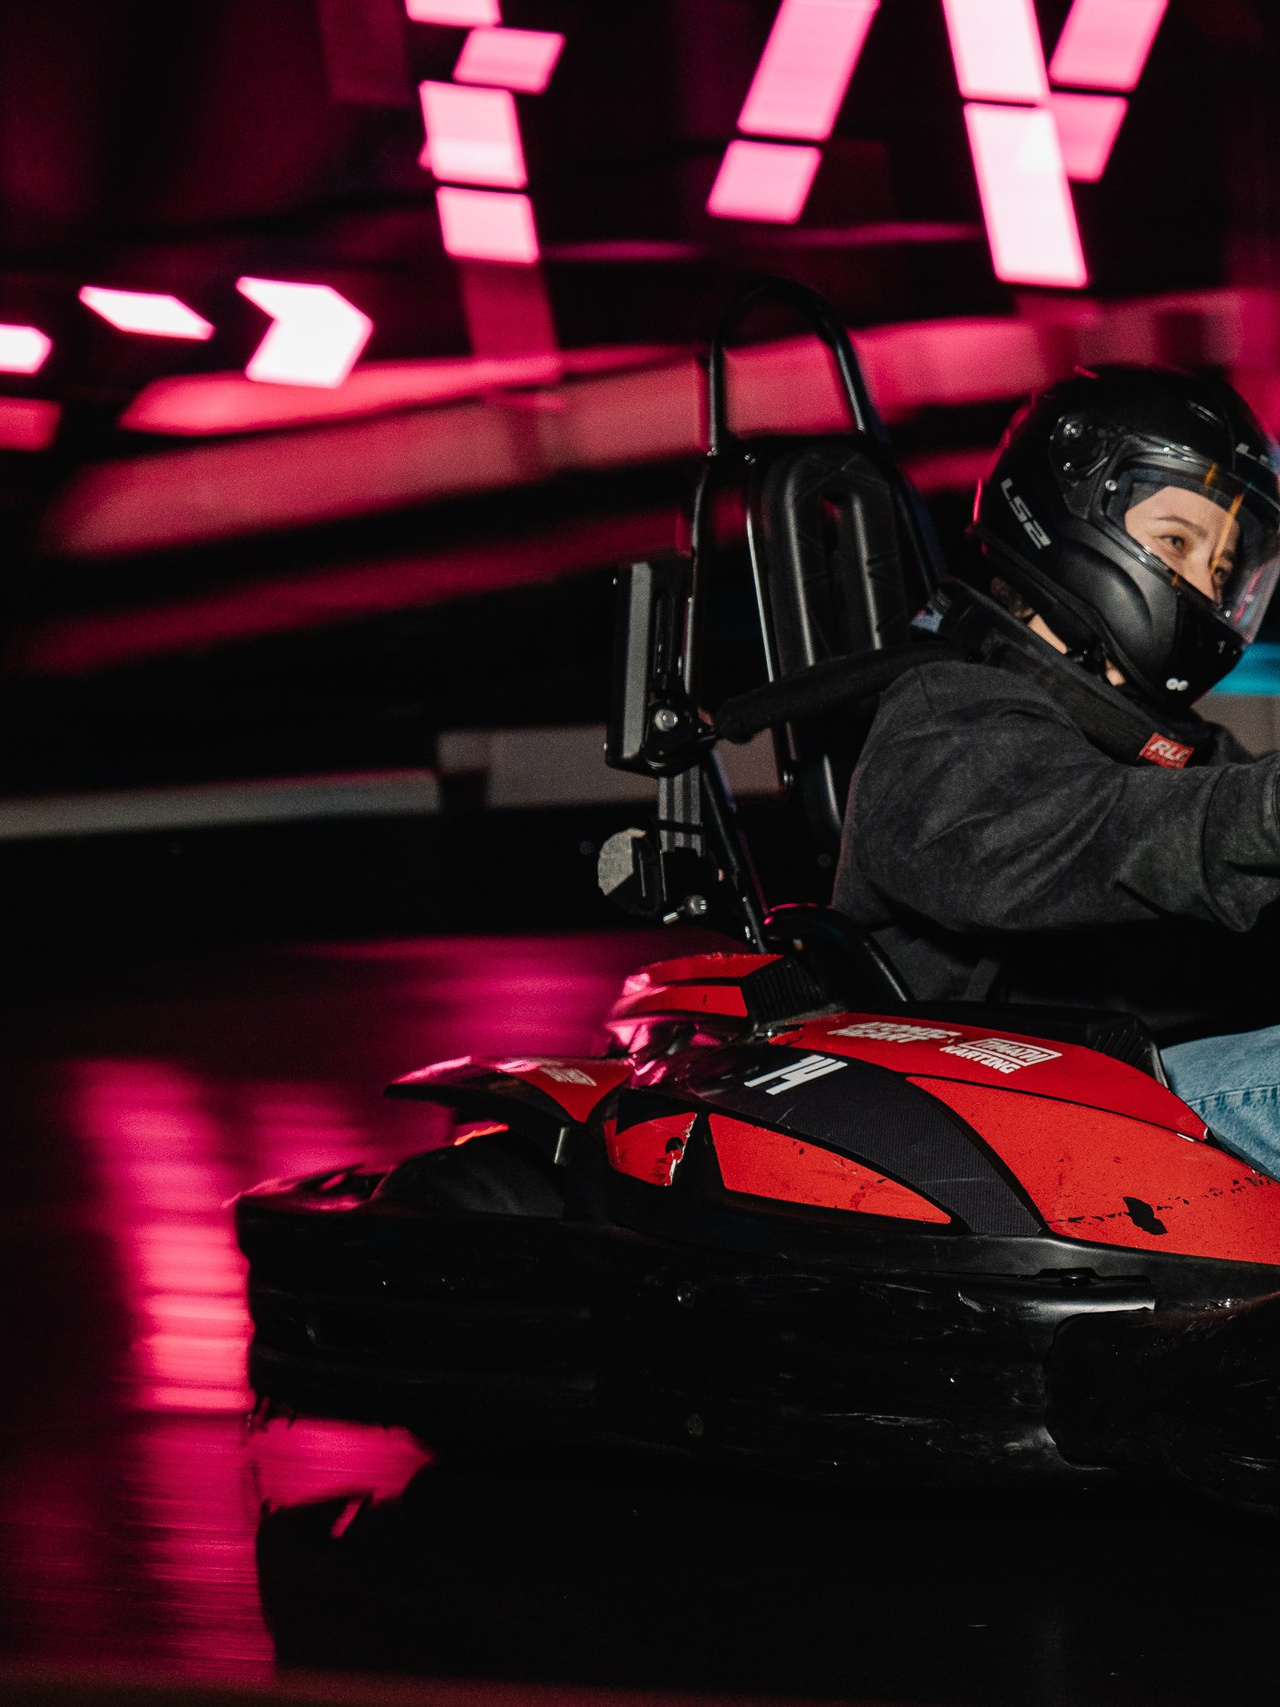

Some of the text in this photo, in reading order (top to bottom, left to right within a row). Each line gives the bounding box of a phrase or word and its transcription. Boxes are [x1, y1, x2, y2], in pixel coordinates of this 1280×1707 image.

[1001, 478, 1051, 549] LS2
[743, 1054, 848, 1095] 14
[939, 1045, 1021, 1074] KARTING
